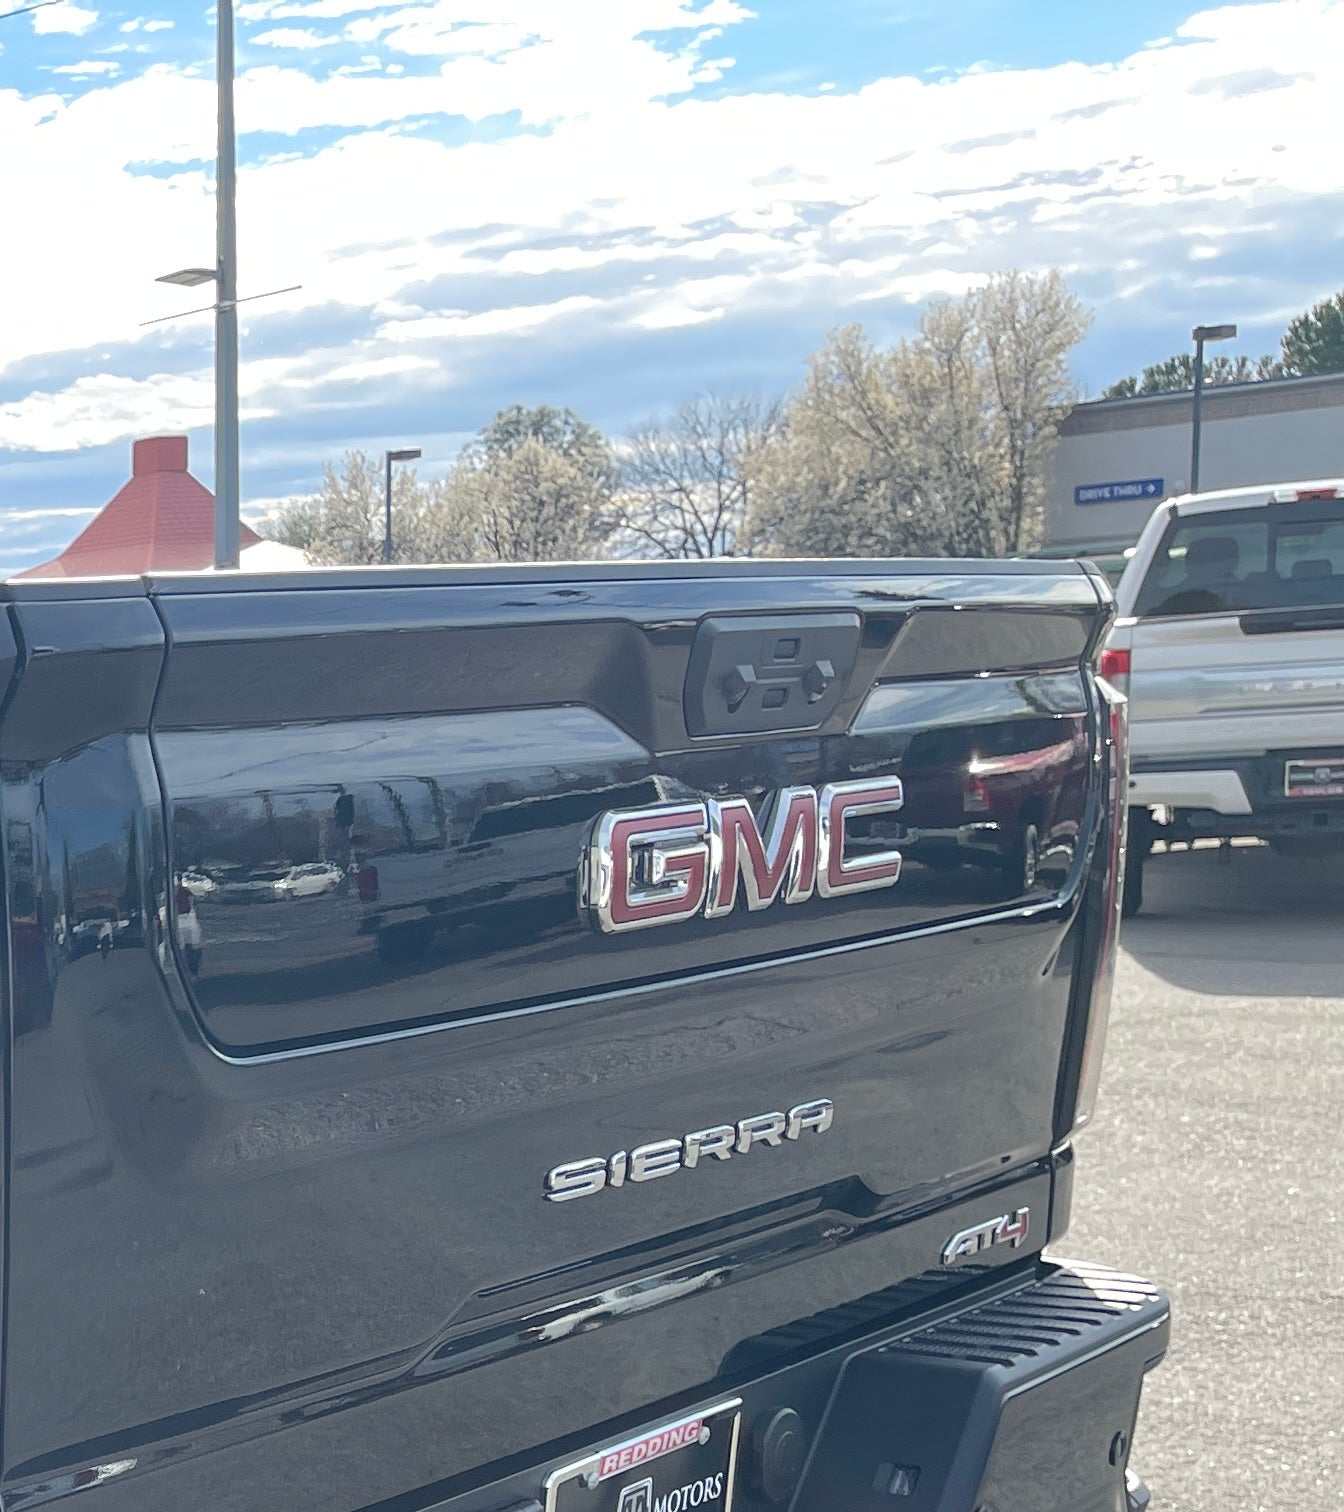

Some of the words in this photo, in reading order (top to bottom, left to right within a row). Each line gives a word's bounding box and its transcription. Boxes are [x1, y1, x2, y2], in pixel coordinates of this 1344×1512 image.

[1079, 486, 1111, 501] DRIVE
[1113, 484, 1143, 498] THRU
[580, 775, 904, 933] GMC
[543, 1098, 834, 1202] SIERRA
[940, 1206, 1030, 1266] AT4
[602, 1422, 700, 1474] REDDING
